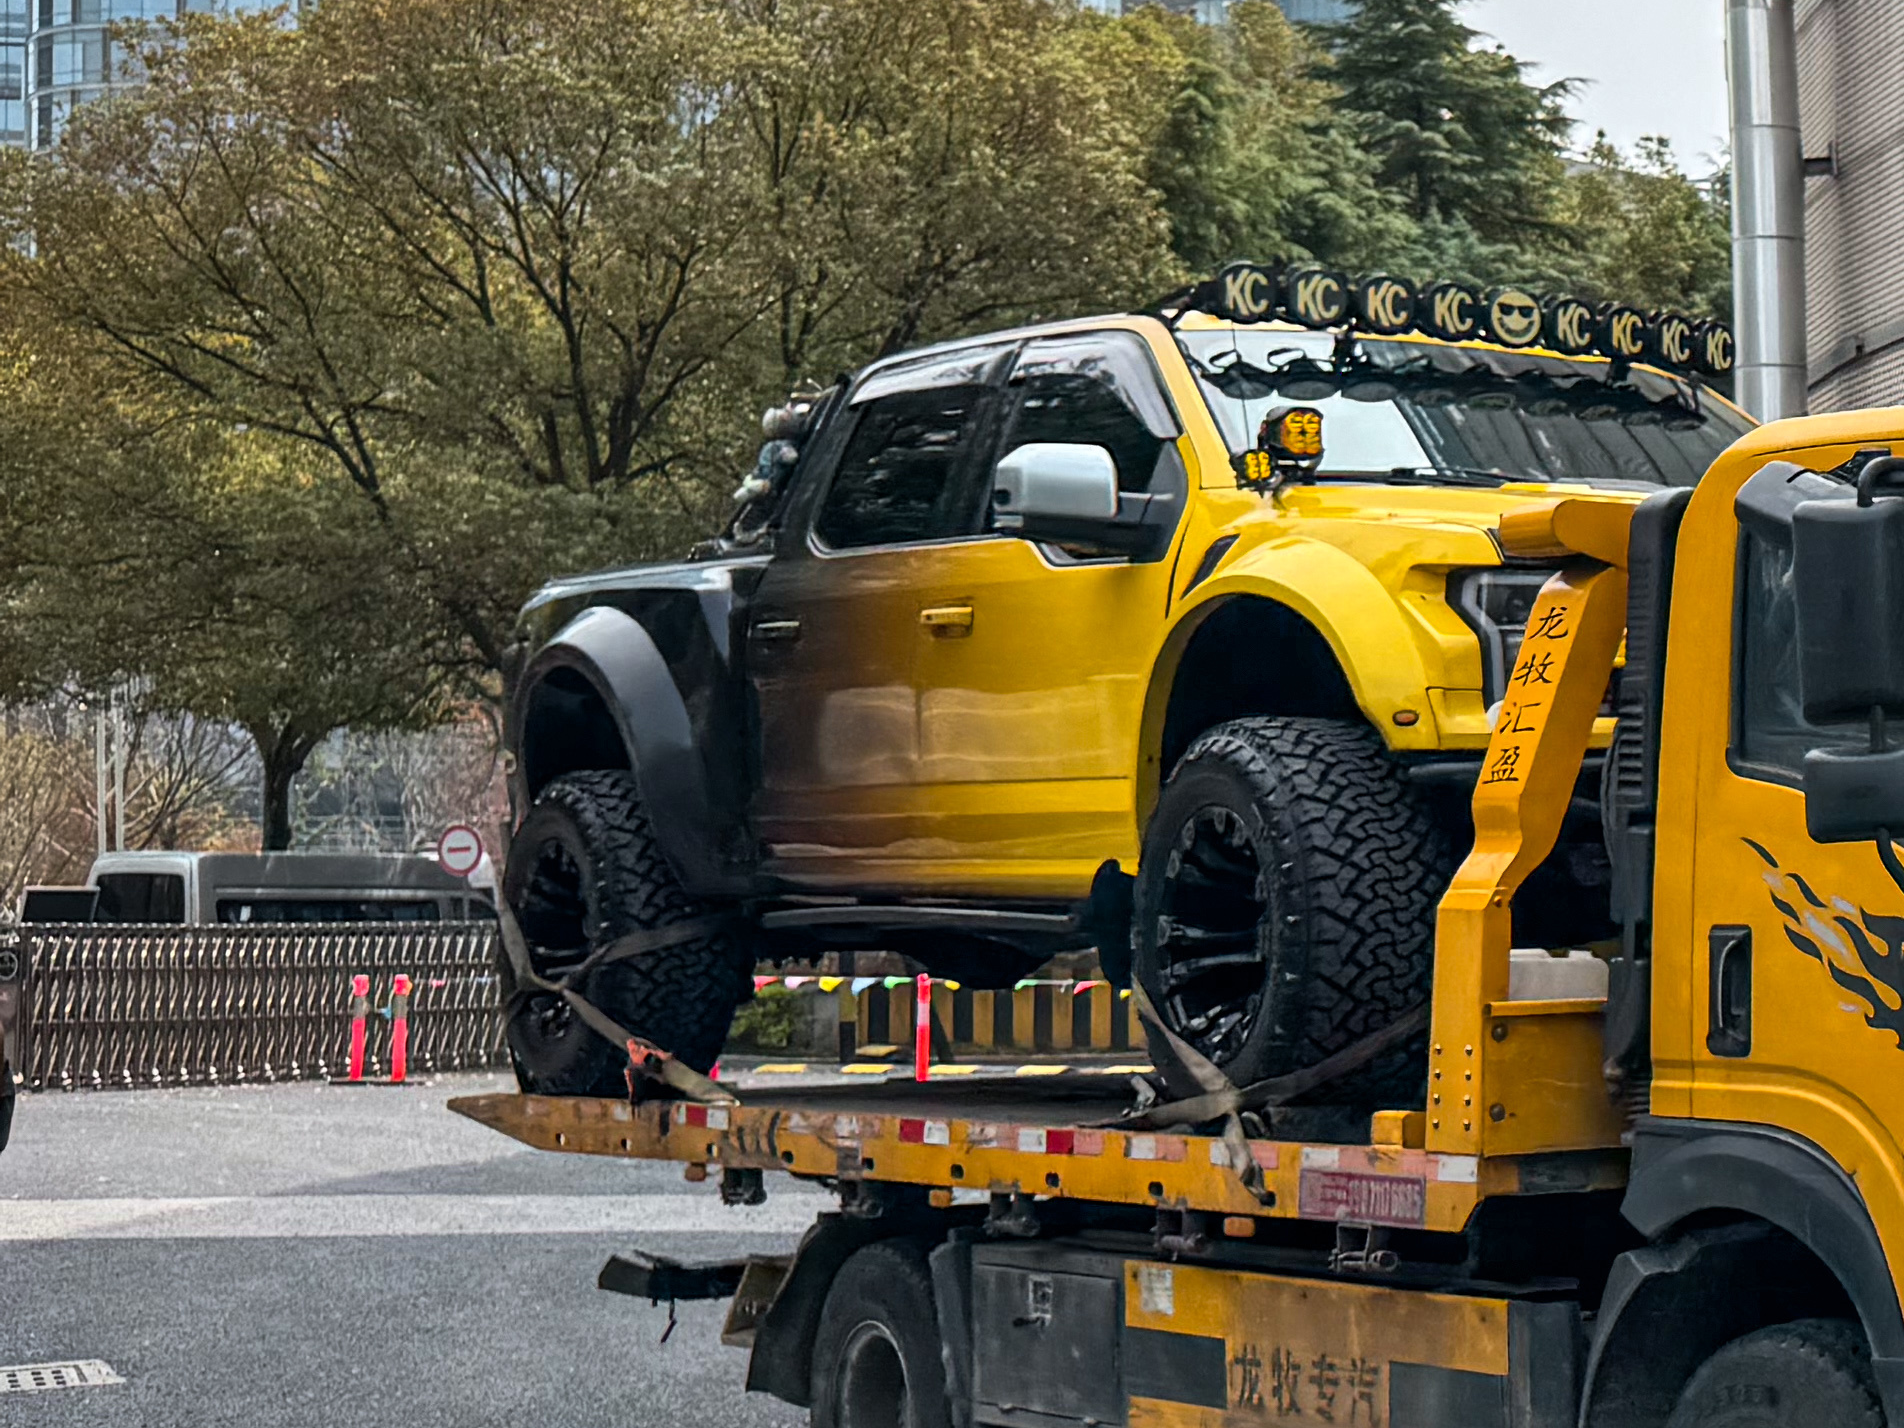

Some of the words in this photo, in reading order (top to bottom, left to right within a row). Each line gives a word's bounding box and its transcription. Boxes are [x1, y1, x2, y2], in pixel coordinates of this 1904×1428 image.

[1225, 268, 1269, 317] KC
[1297, 273, 1340, 321] KC
[1367, 280, 1408, 327] KC
[1434, 287, 1474, 334] KC
[1557, 303, 1592, 349] KC
[1612, 311, 1644, 356] KC
[1662, 318, 1691, 363] KC
[1706, 327, 1733, 370] KC
[1481, 605, 1570, 785] 龙牧汇盈
